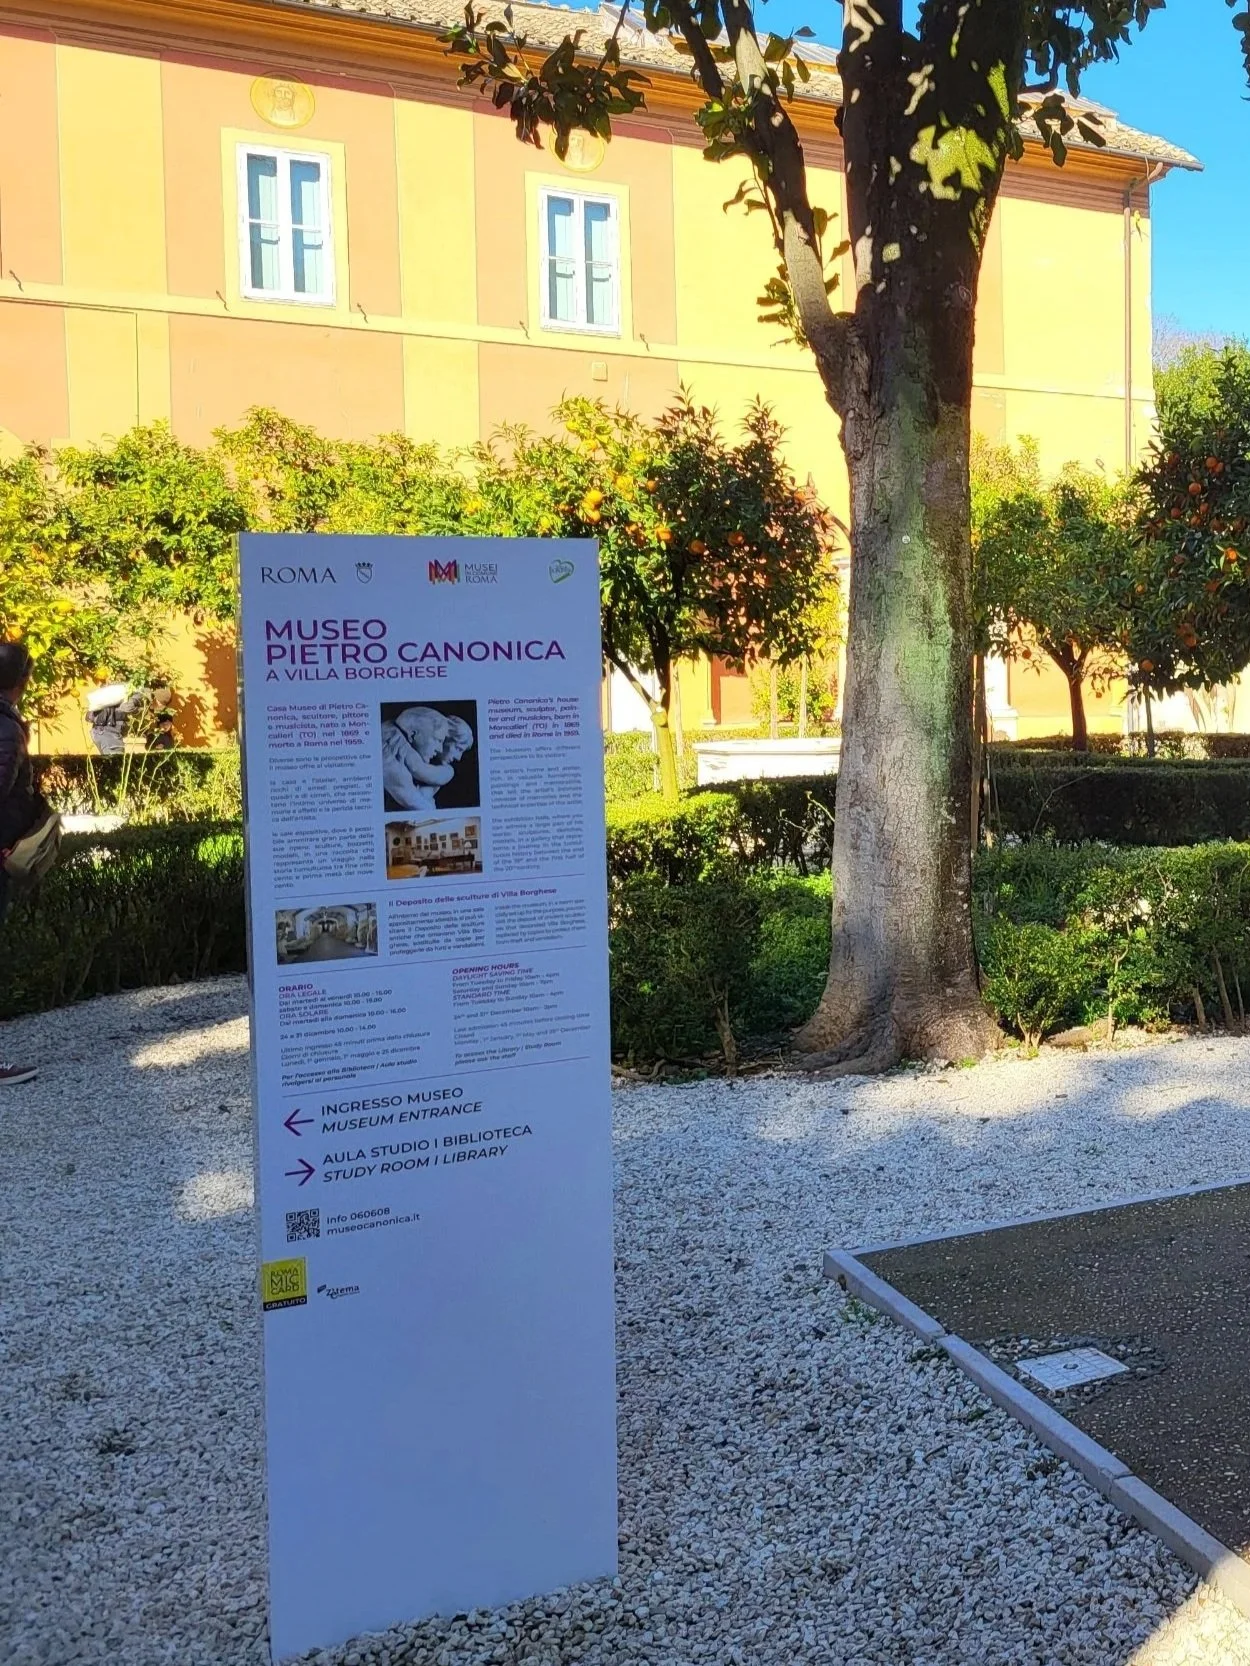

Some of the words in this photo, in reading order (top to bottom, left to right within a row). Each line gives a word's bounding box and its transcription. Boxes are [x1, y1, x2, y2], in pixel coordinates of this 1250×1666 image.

[261, 566, 337, 585] ROMA
[465, 563, 498, 572] MUSEI
[466, 575, 498, 584] ROMA
[266, 619, 388, 641] MUSEO
[267, 642, 388, 666] PIETRO
[397, 640, 566, 663] CANONICA
[266, 668, 280, 682] A
[285, 667, 339, 681] VILLA
[345, 665, 448, 680] BORGHESE
[396, 898, 433, 906] Deposito
[456, 894, 490, 902] sculture
[500, 890, 518, 898] Villa
[520, 888, 557, 896] Borghese
[452, 965, 490, 974] OPENING
[491, 962, 519, 970] HOURS
[278, 984, 314, 992] ORARIO
[321, 1095, 403, 1116] INGRESSO
[407, 1087, 464, 1104] MUSEO
[322, 1114, 394, 1134] MUSEUM
[398, 1102, 483, 1123] ENTRANCE
[323, 1149, 367, 1165] AULA
[371, 1140, 430, 1158] STUDIO
[443, 1124, 532, 1148] BIBLIOTECA
[323, 1164, 377, 1182] STUDY
[380, 1156, 430, 1174] ROOM
[443, 1145, 509, 1164] LIBRARY
[326, 1213, 348, 1225] Info
[350, 1207, 390, 1220] 060608
[326, 1212, 421, 1236] museocanonica.it
[270, 1274, 300, 1288] MIC
[271, 1284, 300, 1295] CARD
[265, 1298, 306, 1310] GRATUITO
